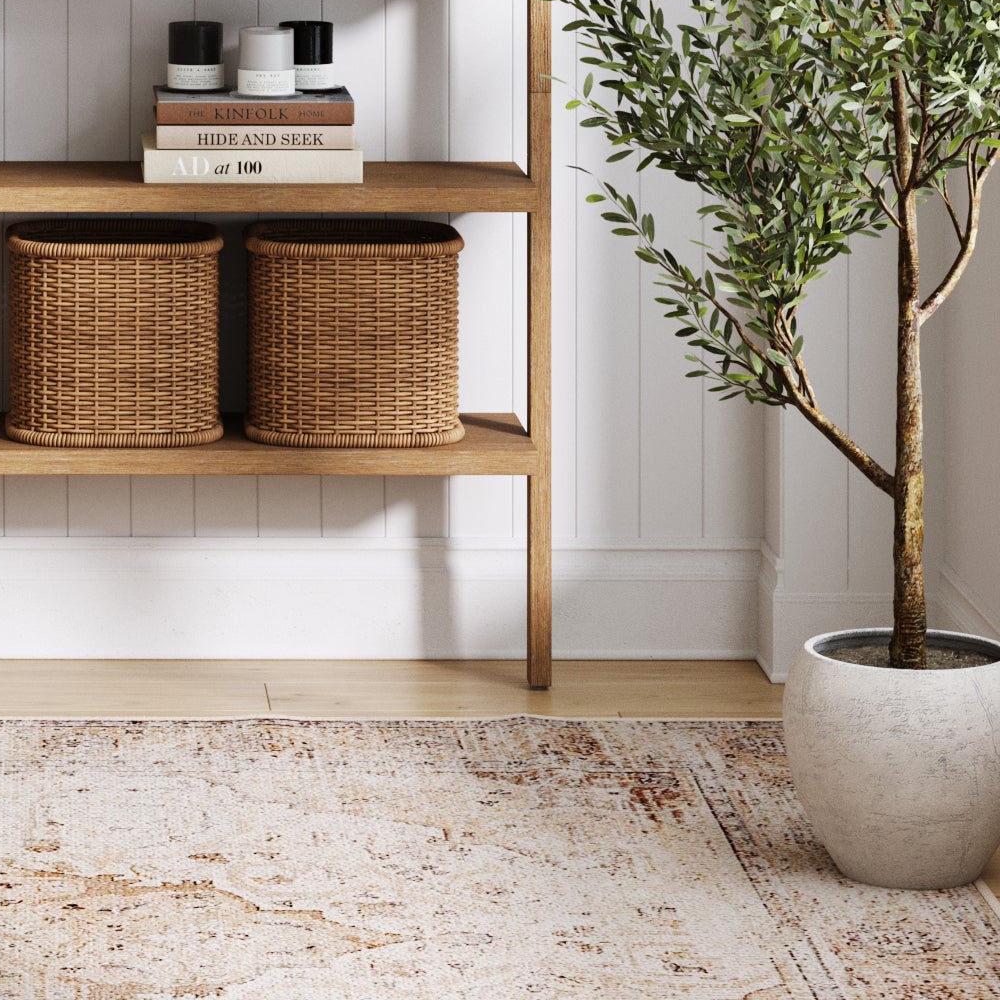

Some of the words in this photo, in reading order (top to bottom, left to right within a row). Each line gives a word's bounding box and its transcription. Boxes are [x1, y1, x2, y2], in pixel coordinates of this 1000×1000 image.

[214, 108, 289, 120] KINFOLK
[197, 133, 238, 146] HIDE
[241, 133, 276, 146] AND
[281, 133, 324, 146] SEEK
[172, 156, 210, 176] AD
[214, 162, 231, 175] at
[236, 161, 263, 175] 100
